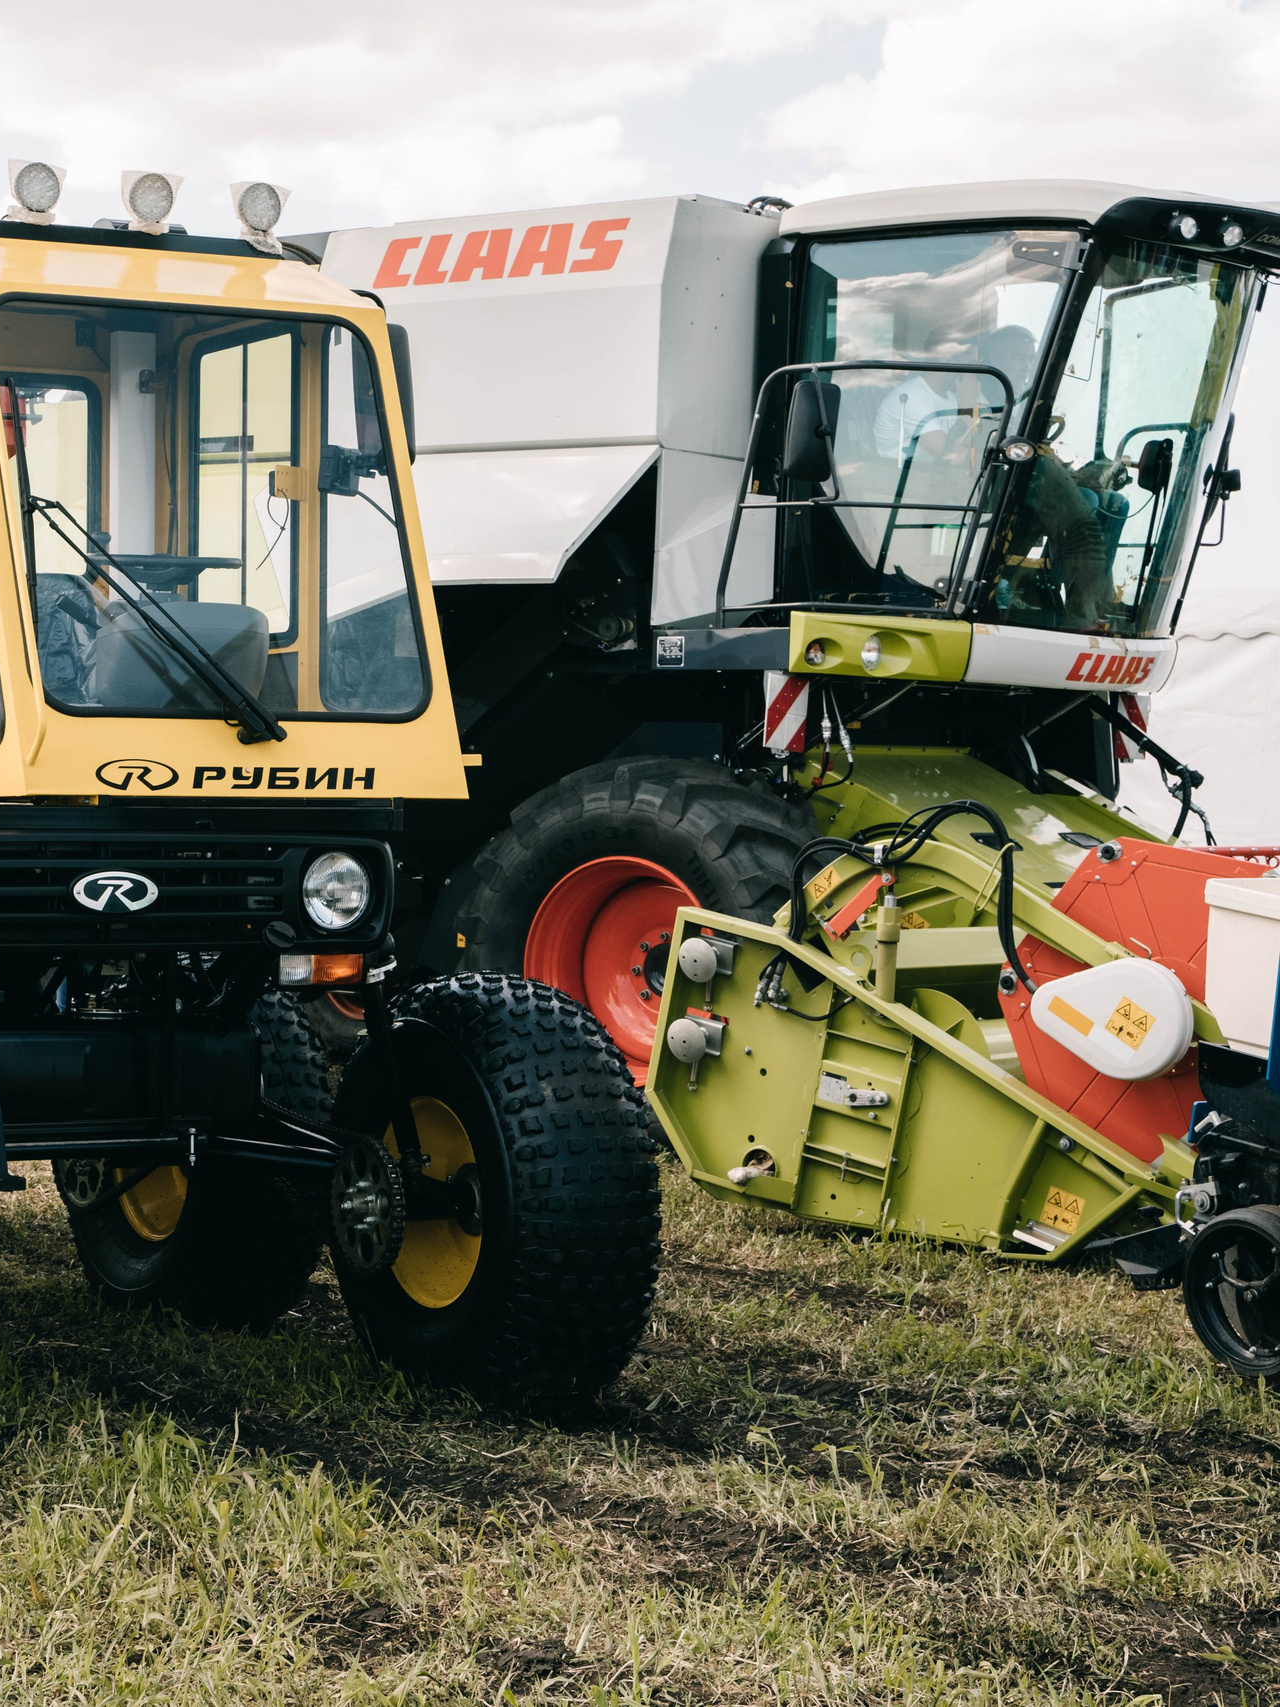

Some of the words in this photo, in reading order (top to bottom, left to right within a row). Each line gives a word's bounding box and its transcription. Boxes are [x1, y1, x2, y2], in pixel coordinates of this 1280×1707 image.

[372, 217, 631, 289] CLAAS
[1065, 652, 1156, 685] CLAAS
[192, 766, 375, 790] РУБИН
